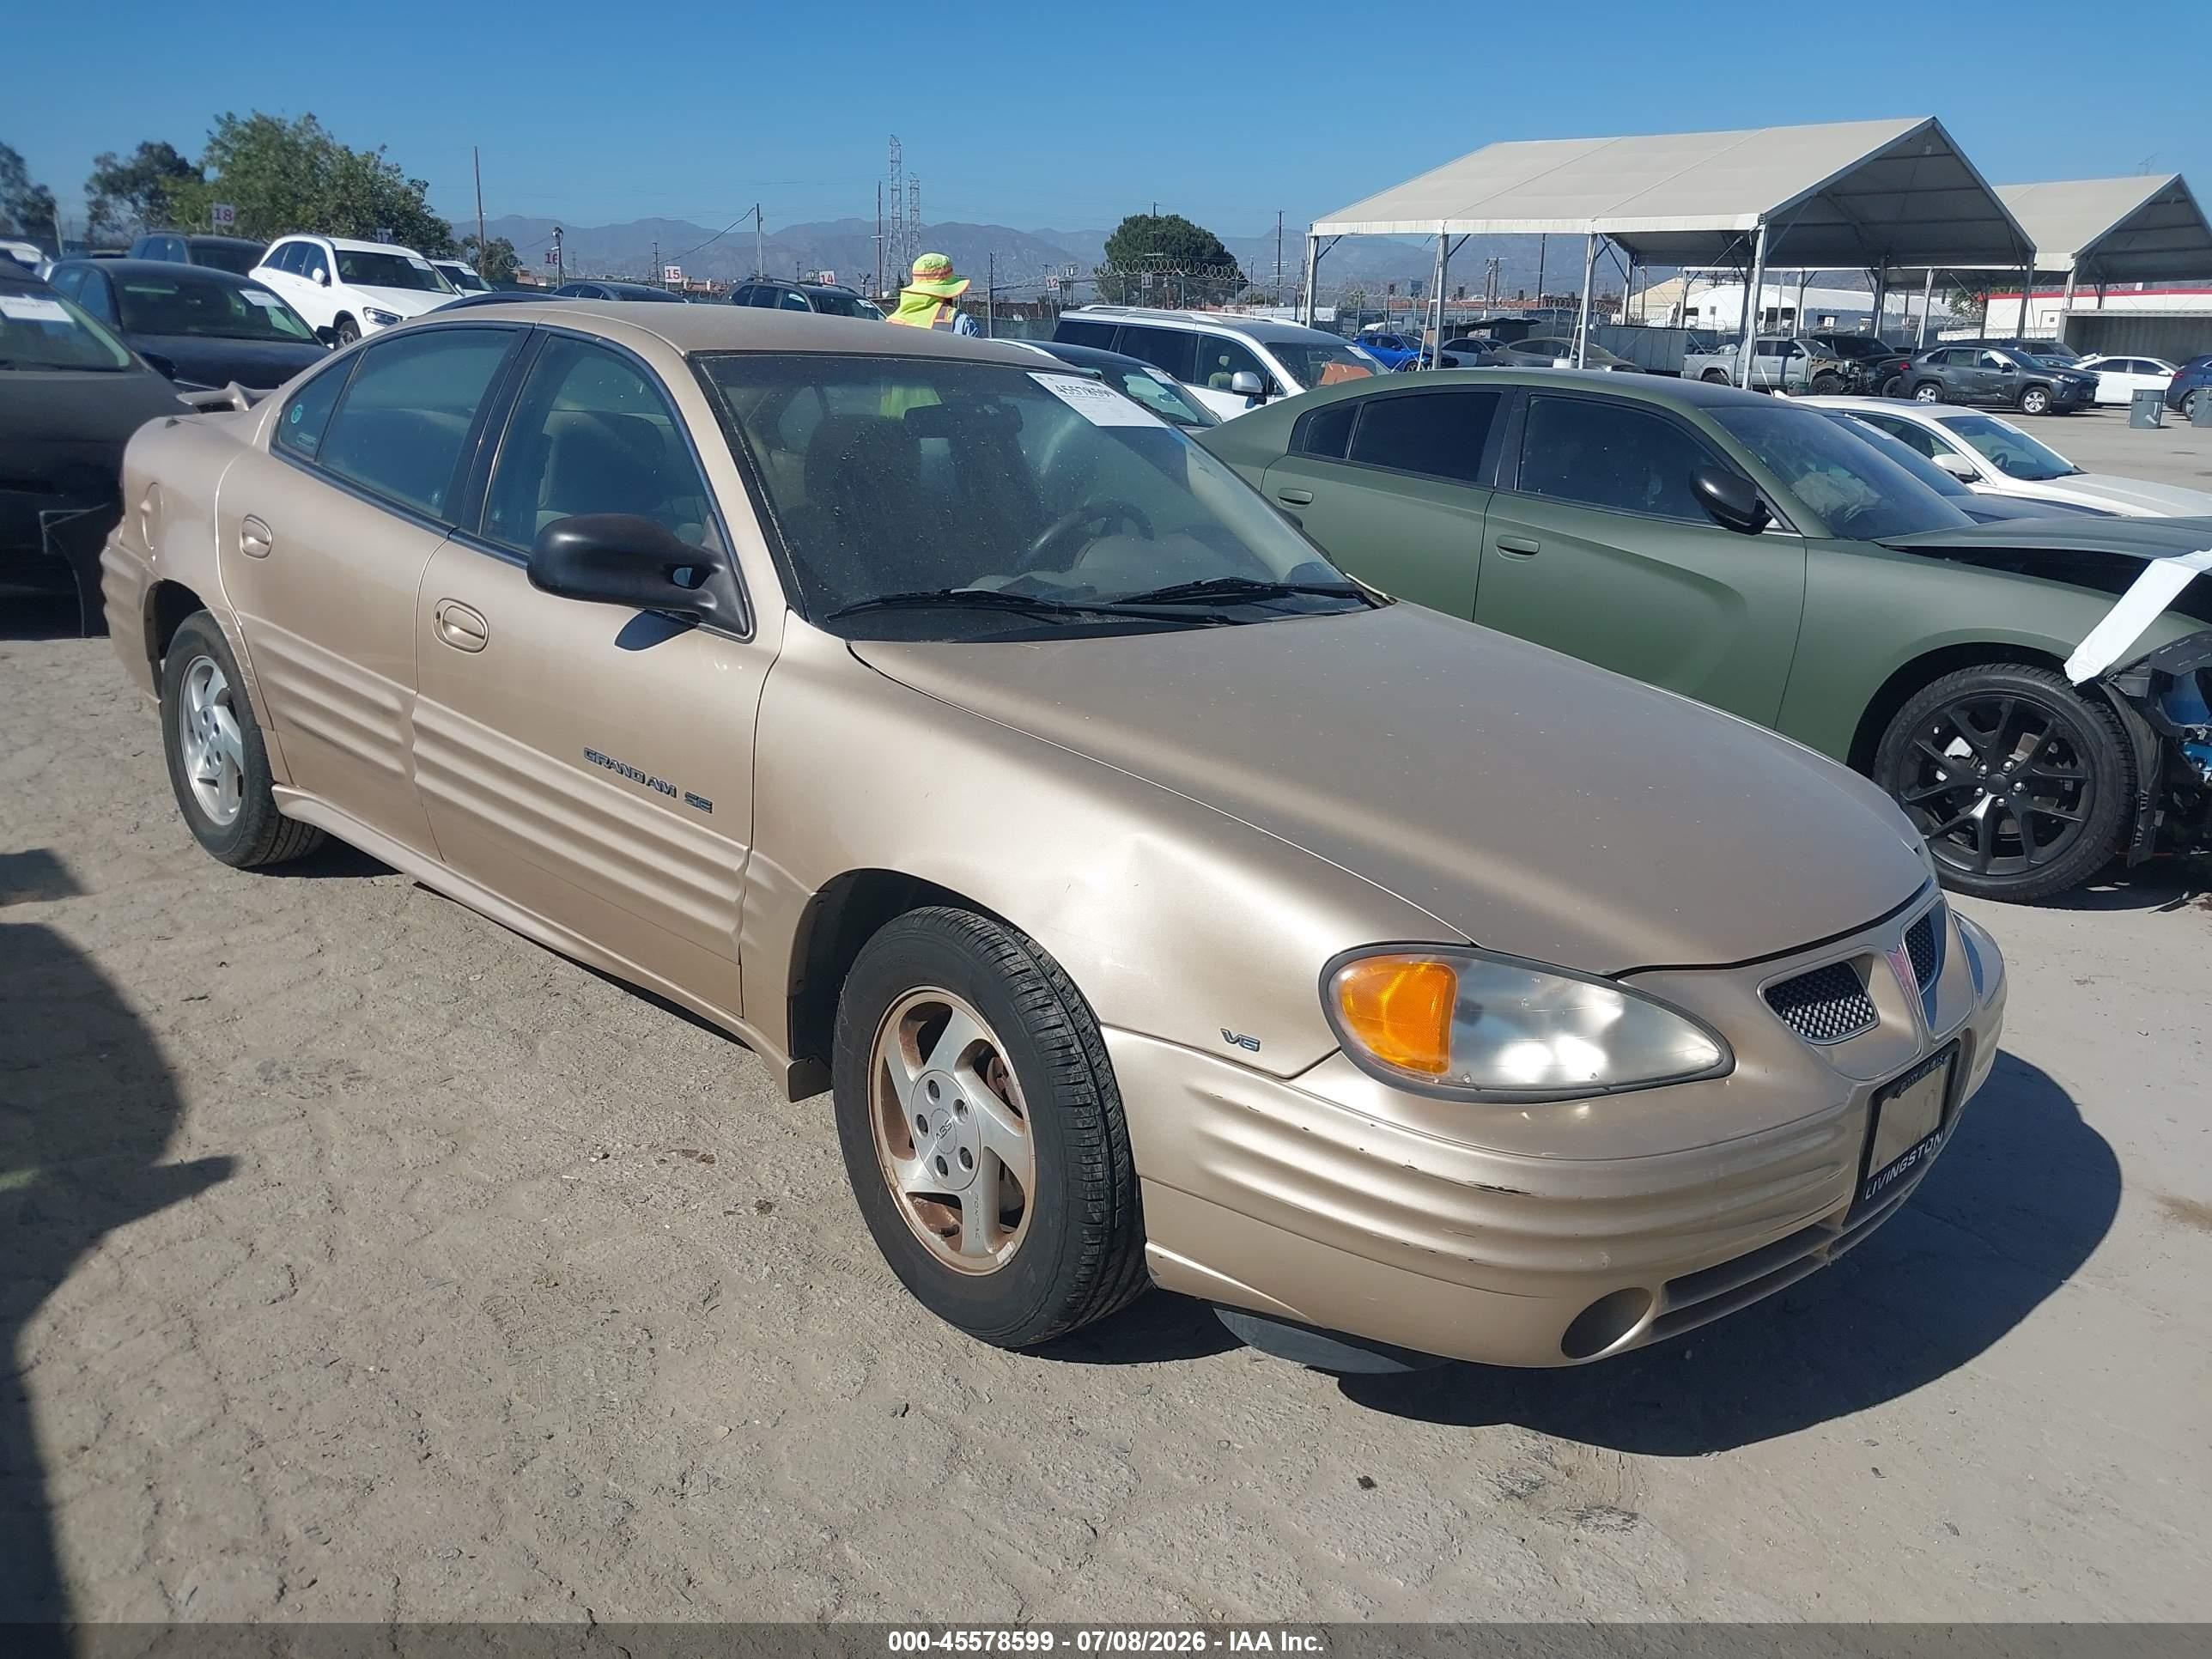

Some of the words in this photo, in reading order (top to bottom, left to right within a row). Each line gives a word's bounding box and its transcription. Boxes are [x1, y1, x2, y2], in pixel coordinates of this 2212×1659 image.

[215, 209, 233, 222] 18
[378, 232, 391, 244] 17
[544, 252, 558, 264] 16
[665, 269, 680, 280] 15
[820, 274, 834, 284] 14
[1047, 278, 1059, 289] 12
[1142, 276, 1152, 286] 11
[583, 747, 646, 785] GRAND
[646, 775, 678, 799] AM
[684, 790, 713, 814] SE
[1220, 1028, 1261, 1052] V6
[935, 1119, 953, 1145] ABS
[1864, 1129, 1945, 1201] LIVINGSTON
